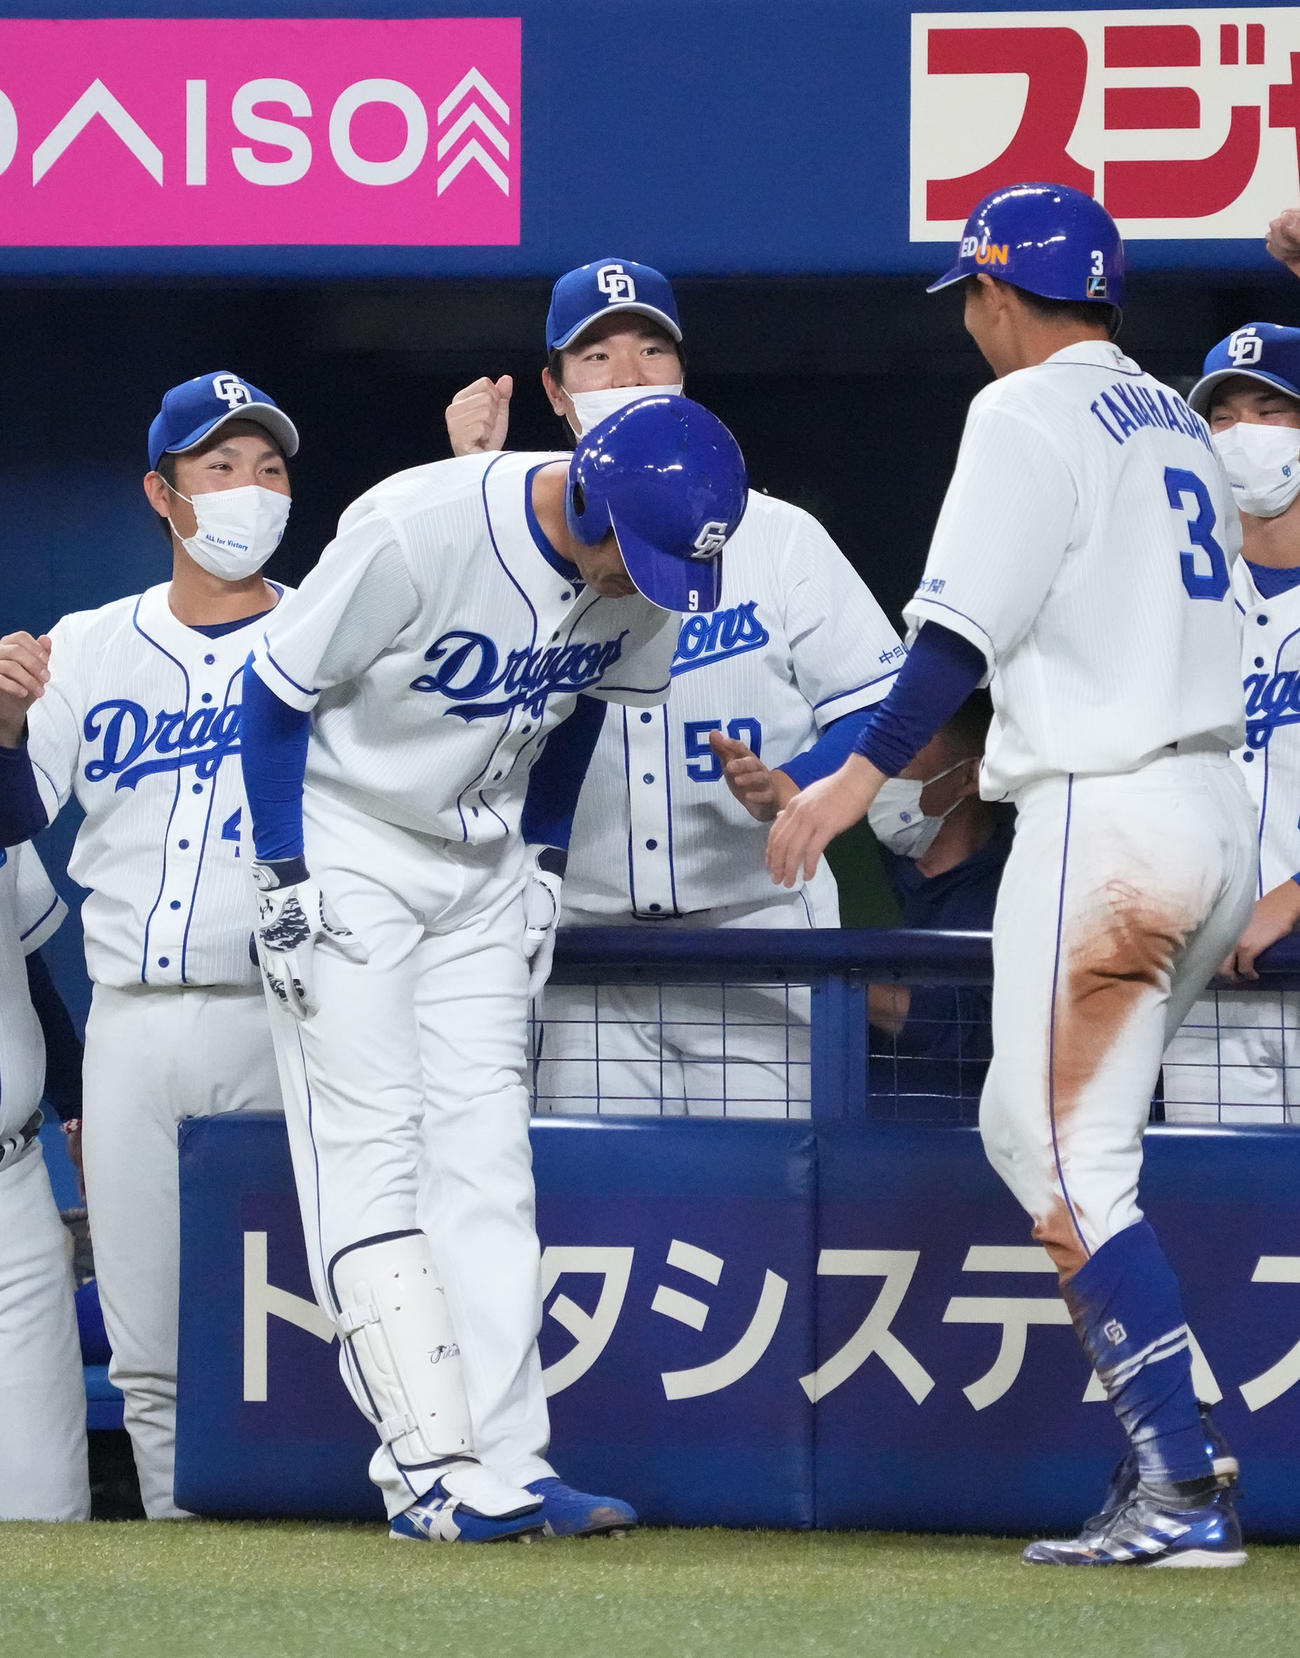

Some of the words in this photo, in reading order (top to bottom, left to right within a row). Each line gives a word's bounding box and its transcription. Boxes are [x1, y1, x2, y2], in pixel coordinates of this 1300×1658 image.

[0, 77, 428, 187] AISO
[961, 235, 1009, 265] EDION
[1090, 250, 1105, 276] 3
[227, 539, 249, 552] Victory
[1164, 466, 1231, 602] 3
[688, 590, 699, 611] 9
[671, 600, 770, 665] ons
[879, 643, 909, 665] 中日
[84, 698, 242, 782] Drag
